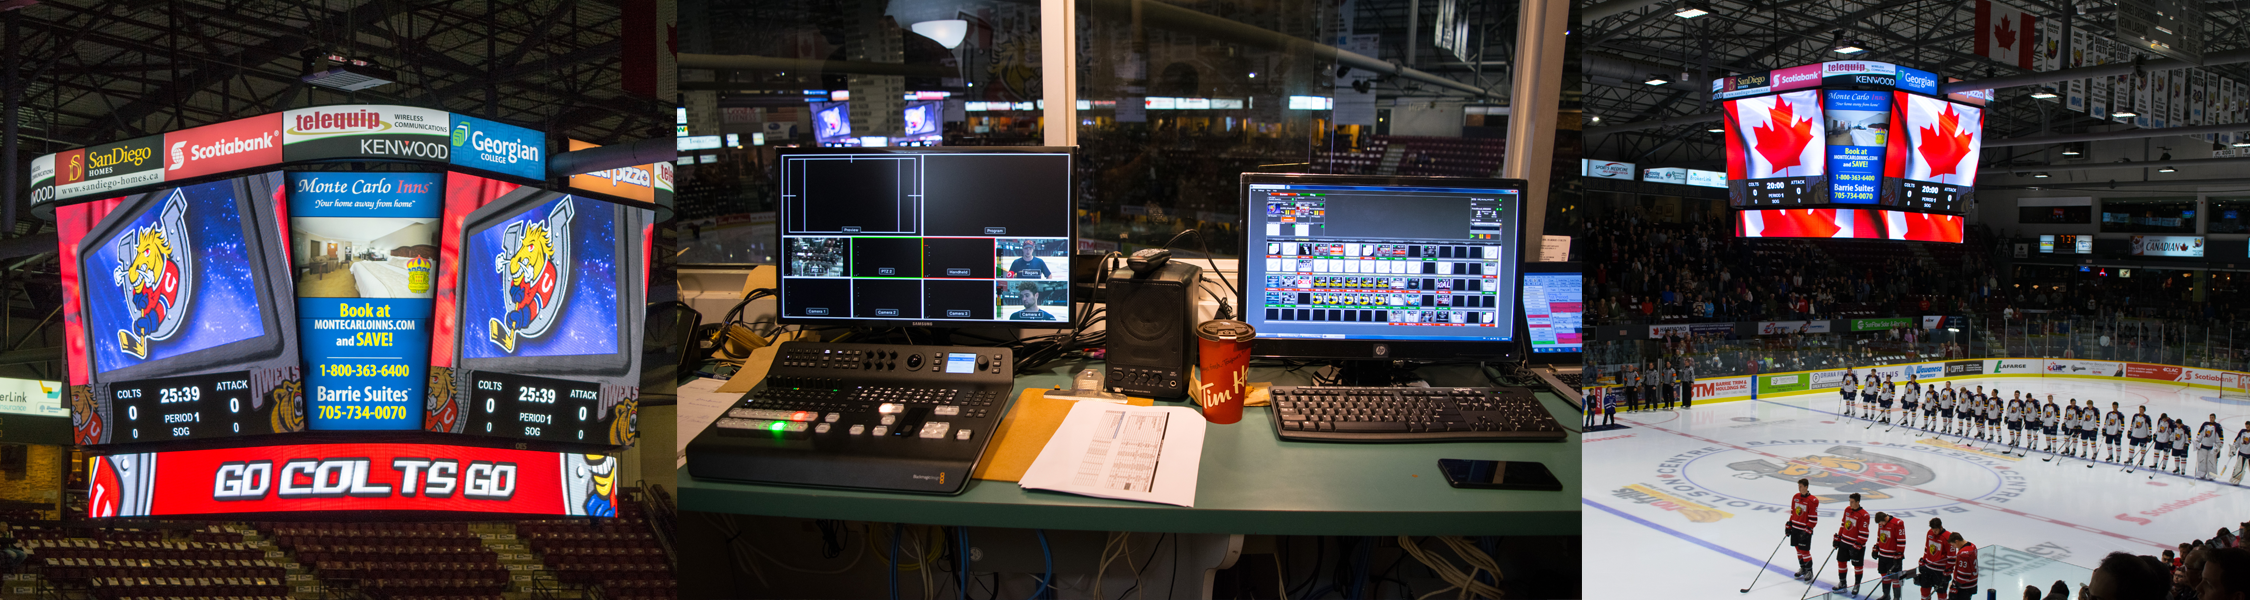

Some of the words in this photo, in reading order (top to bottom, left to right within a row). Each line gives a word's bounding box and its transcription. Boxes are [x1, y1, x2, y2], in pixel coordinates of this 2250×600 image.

[2047, 27, 2059, 35] COLTS
[2118, 16, 2132, 30] KEVIN
[2131, 20, 2148, 36] LABANC
[2095, 36, 2109, 47] BARRIE
[2095, 45, 2108, 55] COLTS
[1828, 62, 1866, 72] telequip
[1737, 75, 1766, 86] SanDiego
[1782, 72, 1819, 84] Scotiabank
[1855, 75, 1895, 86] KENWOOD
[1905, 73, 1935, 88] Georgian
[1828, 92, 1850, 100] Monte
[1851, 92, 1869, 101] Carlo
[1871, 93, 1886, 101] Inns
[296, 109, 380, 131] telequip
[394, 114, 424, 122] WIRELESS
[394, 122, 448, 133] COMMUNICATIONS
[191, 132, 273, 161] Scotiabank
[361, 139, 448, 159] KENWOOD
[471, 131, 539, 164] Georgian
[89, 145, 152, 169] SanDiego
[481, 152, 507, 165] COLLEGE
[88, 167, 113, 177] HOMES
[61, 173, 159, 195] www.sandiego-homes.ca
[298, 178, 348, 194] Monte
[352, 178, 391, 195] Carlo
[396, 180, 429, 194] Inns
[1766, 182, 1785, 190] 20:00
[1834, 184, 1853, 192] Barrie
[1854, 184, 1874, 192] Suites
[1796, 187, 1801, 195] 0
[1907, 190, 1912, 198] 0
[1921, 186, 1939, 194] 20:00
[1834, 192, 1873, 200] 705-734-0070
[315, 199, 333, 209] Your
[334, 199, 353, 208] home
[354, 201, 374, 210] away
[374, 199, 393, 210] from
[393, 199, 413, 208] home
[2145, 242, 2180, 252] CANADIAN
[339, 303, 374, 318] Book
[376, 305, 391, 318] at
[314, 319, 415, 331] MONTECARLOINNS.COM
[336, 335, 355, 346] and
[356, 332, 393, 347] SAVE!
[319, 364, 409, 378] 1-800-363-6400
[1878, 370, 1899, 379] TELUS
[1916, 365, 1942, 374] Wawanesa
[2194, 373, 2234, 383] Scotiabank
[216, 380, 248, 391] ATTACK
[478, 380, 502, 391] COLTS
[117, 388, 142, 399] COLTS
[160, 386, 200, 404] 25:39
[317, 386, 361, 403] Barrie
[363, 386, 409, 403] Suites
[518, 386, 556, 404] 25:39
[570, 389, 597, 400] ATTACK
[1201, 383, 1232, 409] Tim
[230, 397, 240, 413] 0
[485, 398, 495, 413] 0
[128, 405, 138, 421] 0
[164, 413, 193, 424] PERIOD
[194, 412, 200, 423] 1
[318, 406, 407, 421] 705-734-0070
[519, 412, 546, 424] PERIOD
[546, 414, 552, 425] 1
[578, 406, 587, 421] 0
[172, 427, 190, 437] SOG
[233, 422, 239, 433] 0
[486, 422, 492, 433] 0
[524, 426, 541, 436] SOG
[132, 428, 138, 439] 0
[578, 429, 584, 440] 0
[1746, 438, 1862, 446] BARRIE
[1656, 445, 1724, 474] CENTRE
[213, 459, 273, 502] GO
[279, 456, 459, 499] COLTS
[463, 461, 517, 500] GO
[1985, 470, 2028, 504] CENTRE
[1661, 478, 1786, 514] MOLSON
[2139, 490, 2222, 517] Scotiabank
[1958, 560, 1968, 568] 33
